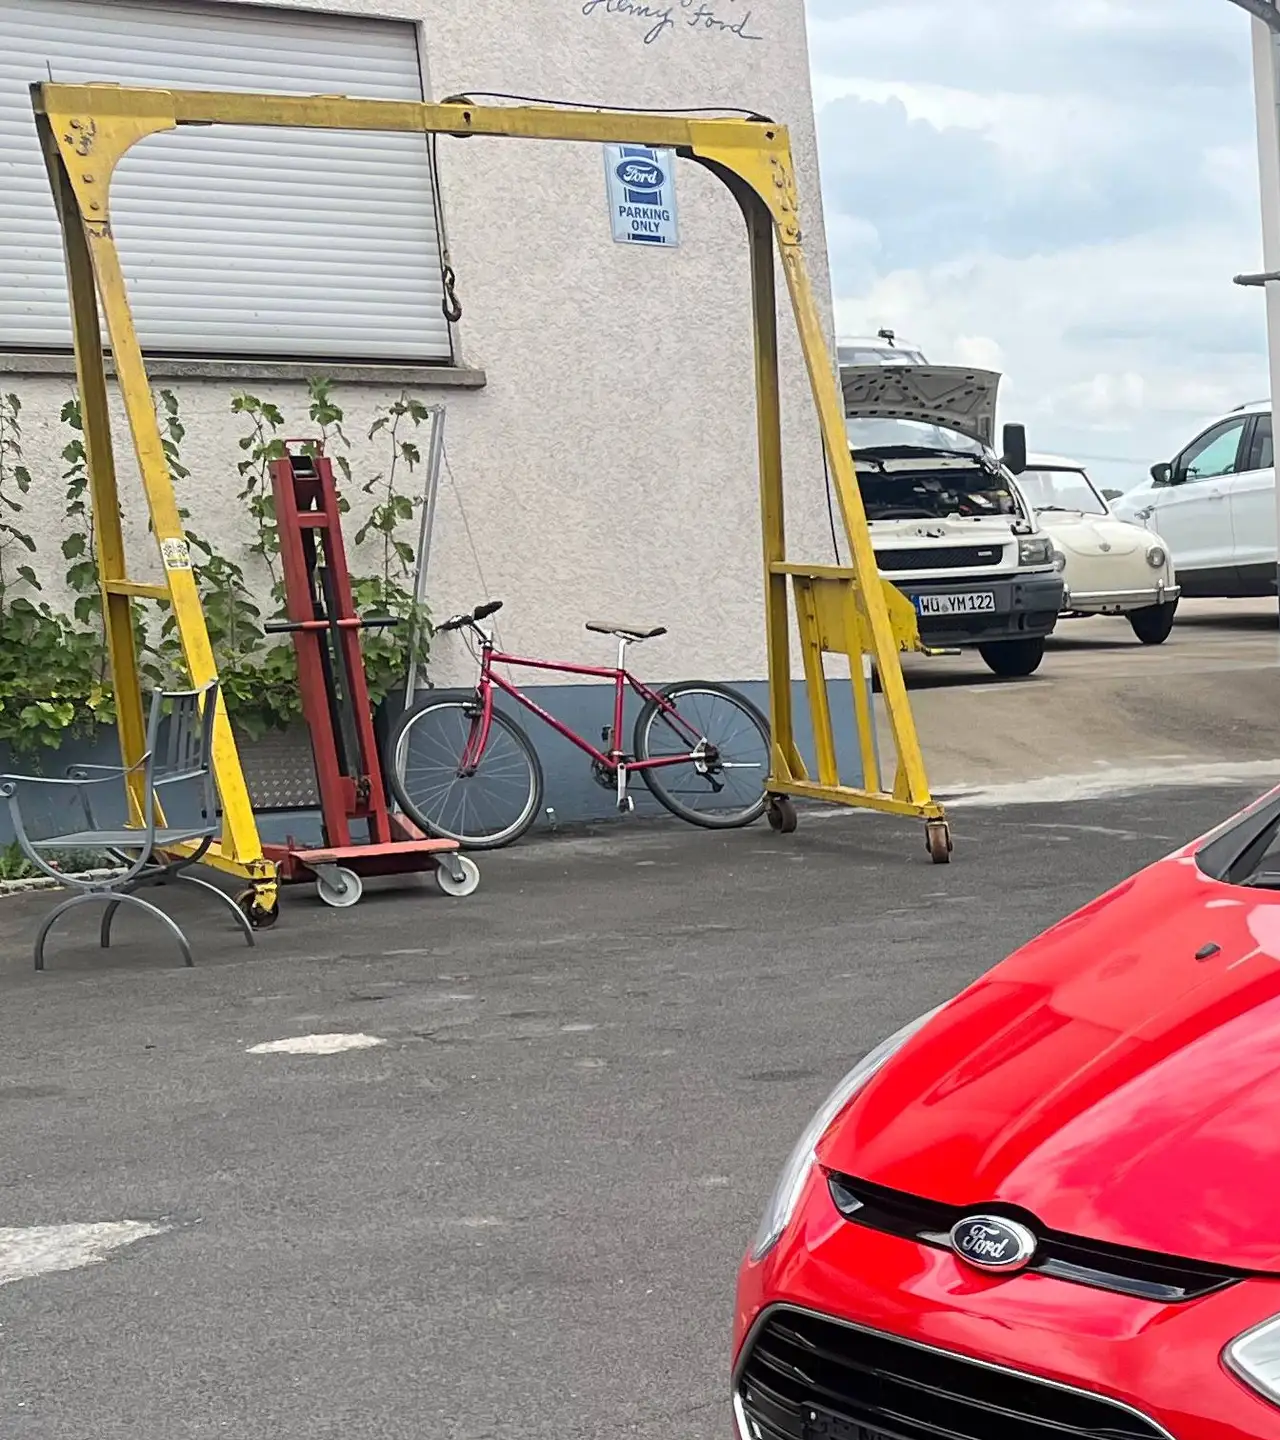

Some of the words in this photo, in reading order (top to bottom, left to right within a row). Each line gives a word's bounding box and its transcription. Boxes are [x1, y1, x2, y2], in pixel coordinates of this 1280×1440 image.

[623, 165, 658, 184] Ford
[619, 206, 670, 221] PARKING
[631, 220, 661, 232] ONLY
[920, 597, 940, 613] WÜ
[962, 1224, 1009, 1258] Ford
